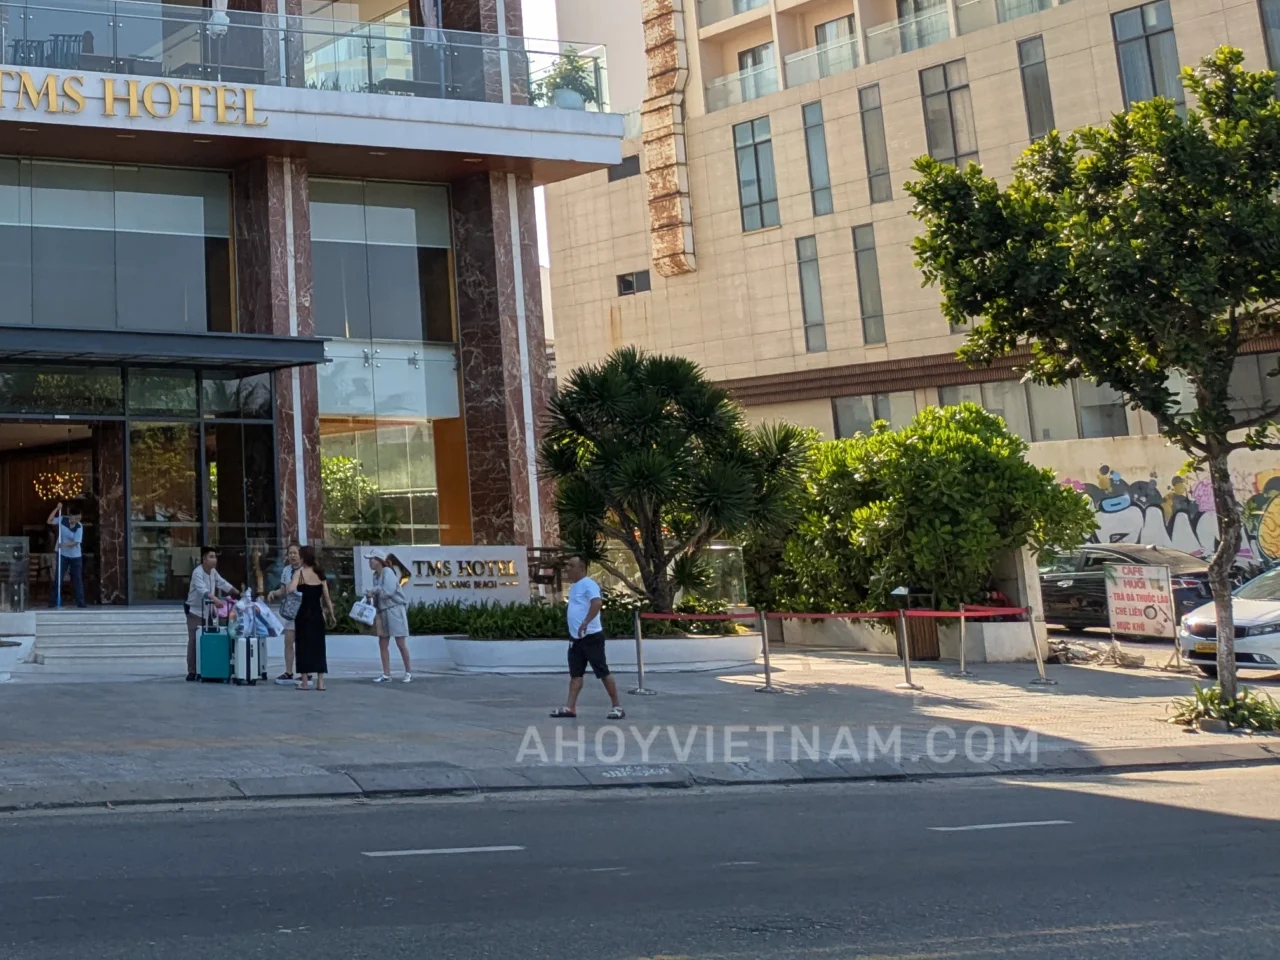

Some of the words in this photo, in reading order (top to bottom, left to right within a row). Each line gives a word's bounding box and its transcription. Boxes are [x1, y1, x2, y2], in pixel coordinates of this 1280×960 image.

[100, 77, 269, 127] HOTEL
[412, 559, 453, 577] TMS
[456, 559, 519, 577] HOTEL
[449, 581, 471, 589] NANG
[473, 580, 498, 589] BEACH
